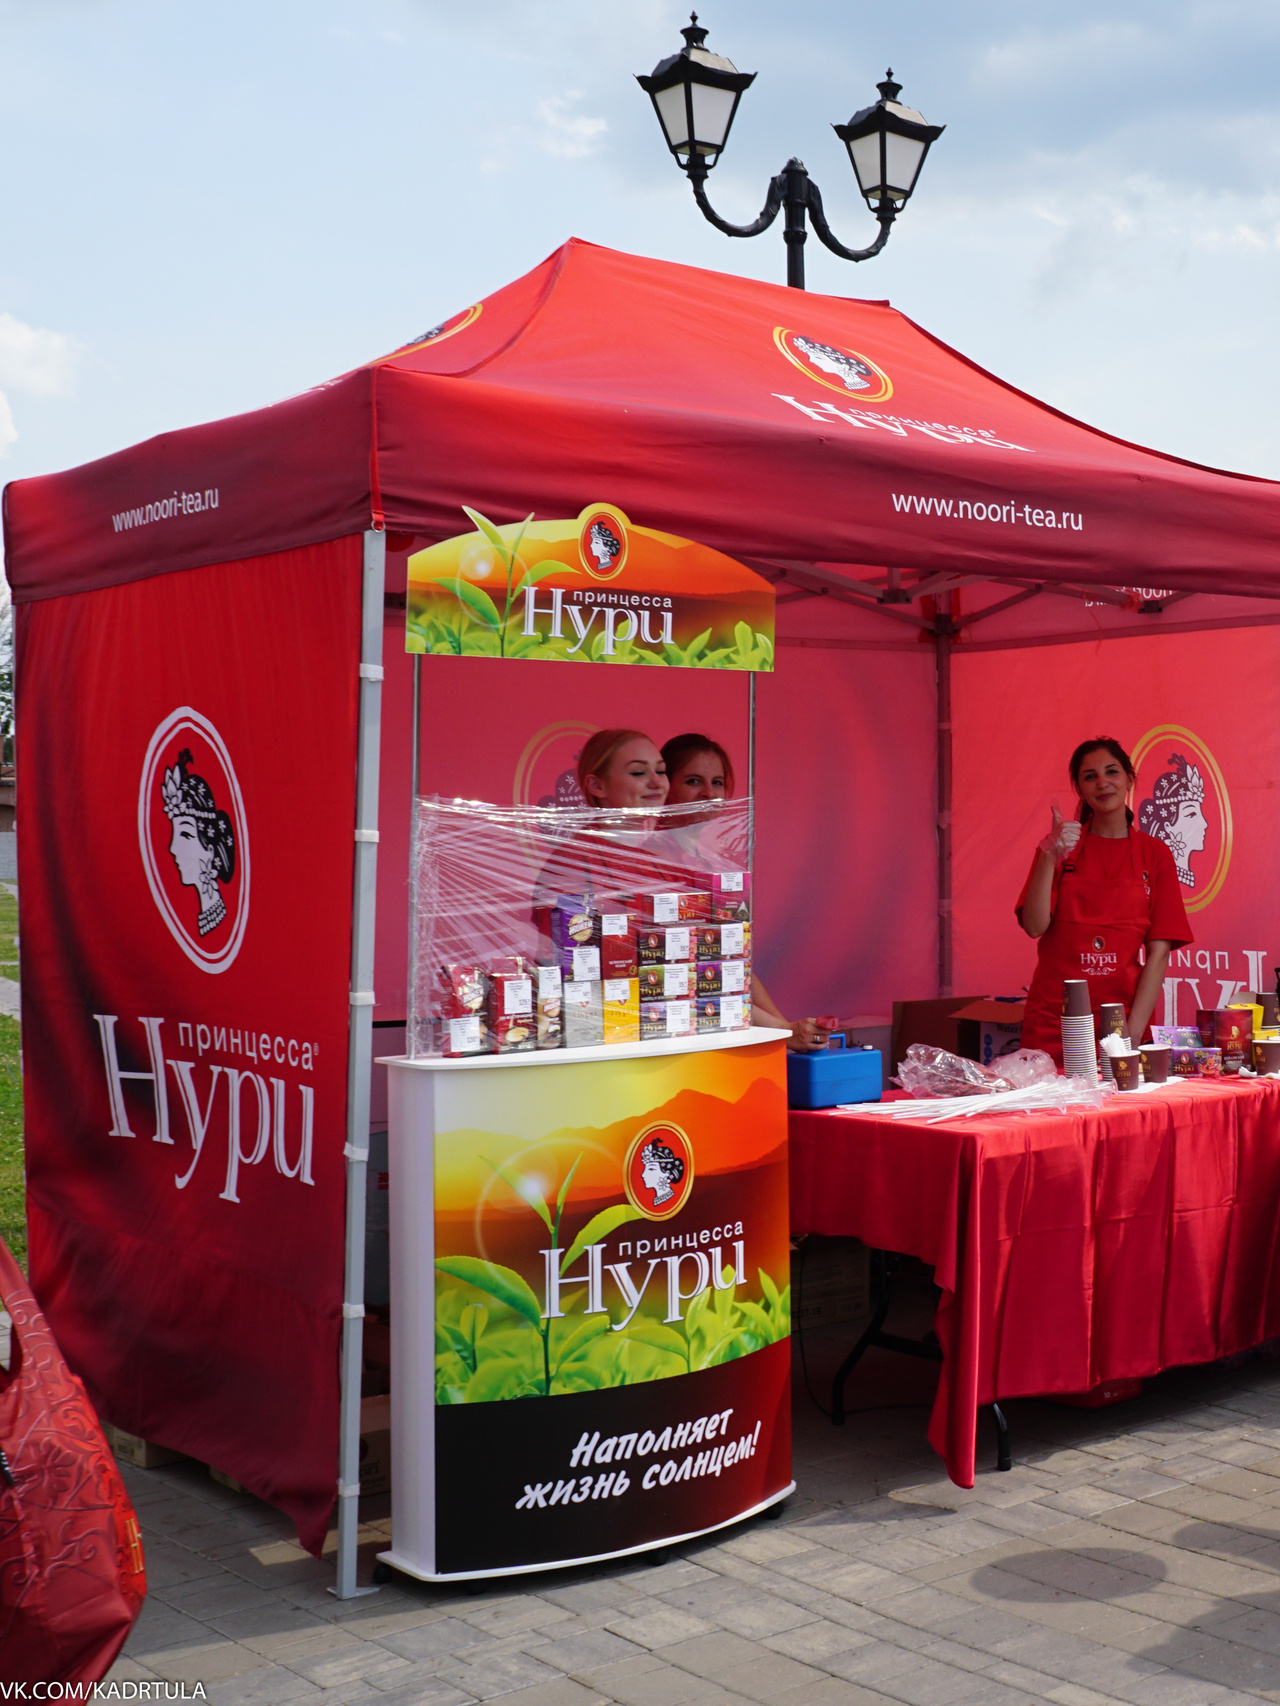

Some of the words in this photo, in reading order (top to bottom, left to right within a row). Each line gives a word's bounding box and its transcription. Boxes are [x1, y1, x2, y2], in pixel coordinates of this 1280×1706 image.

[111, 487, 219, 533] www.noori-tea.ru
[891, 493, 1084, 531] www.noori-tea.ru
[520, 585, 675, 656] Нури
[573, 590, 673, 608] принцесса
[1080, 952, 1118, 967] Нури
[178, 1021, 314, 1071] принцесса
[92, 1013, 315, 1204] Нури
[618, 1221, 744, 1258] принцесса
[539, 1240, 748, 1332] Нури
[569, 1408, 734, 1468] Наполняет
[515, 1470, 631, 1509] жизнь
[641, 1420, 762, 1490] солнцем!
